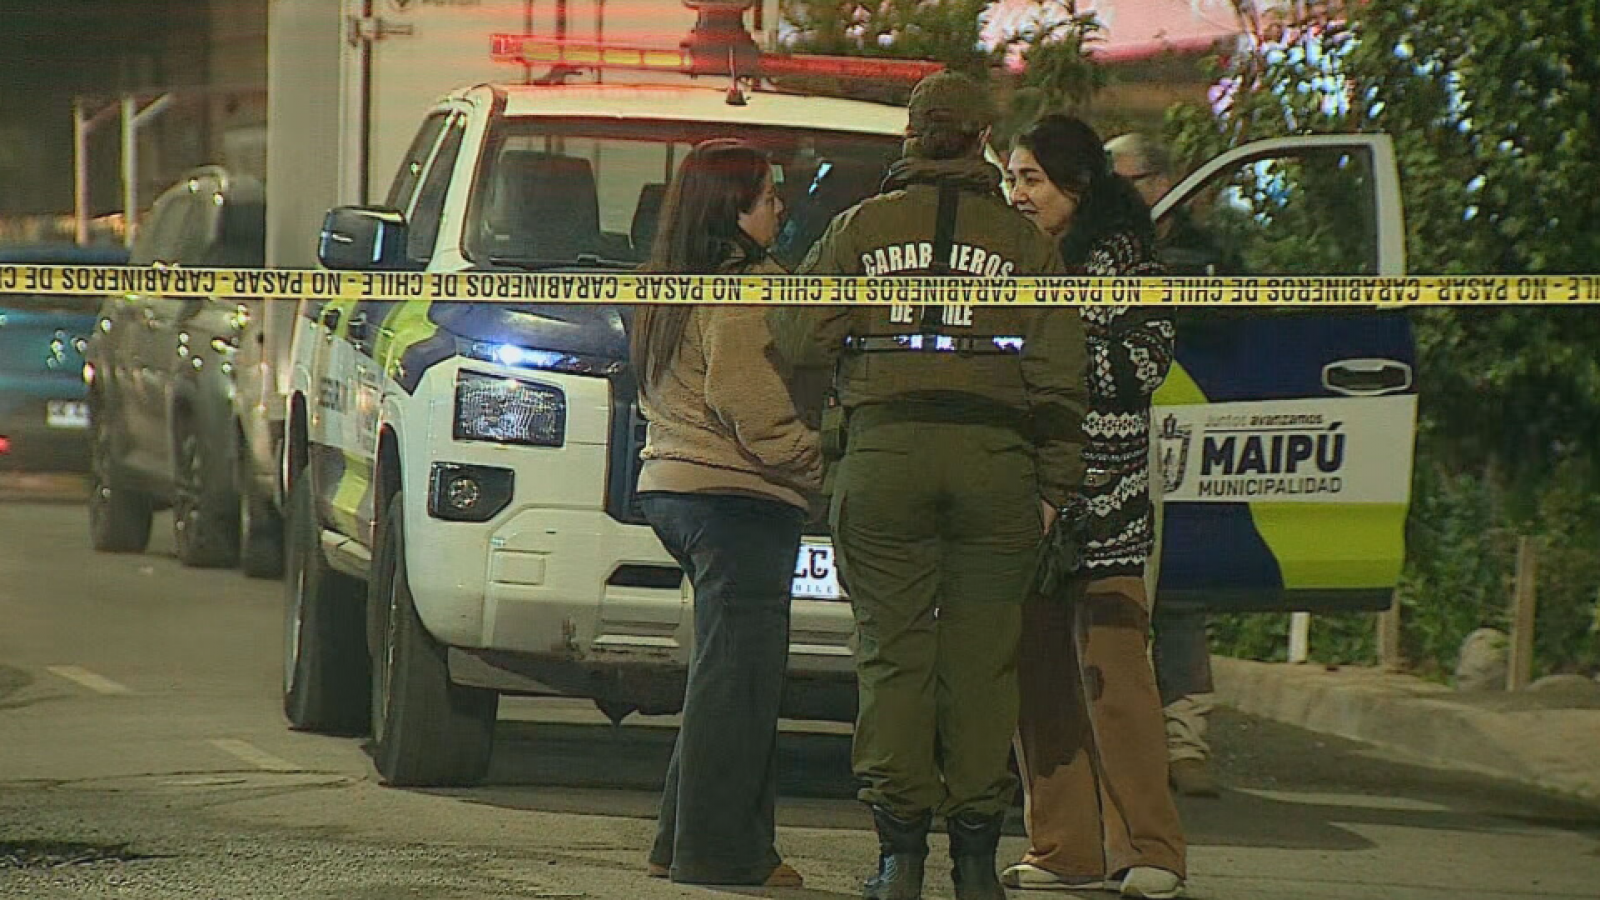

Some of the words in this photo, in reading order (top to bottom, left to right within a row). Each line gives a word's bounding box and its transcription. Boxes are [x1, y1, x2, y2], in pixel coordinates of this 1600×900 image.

[861, 242, 1015, 278] CARABEROS
[25, 267, 53, 290] DE
[62, 268, 216, 293] CARABINEROS
[312, 273, 341, 294] NO
[361, 273, 423, 296] CHILE
[432, 274, 457, 296] DE
[467, 274, 618, 299] CARABINEROS
[713, 277, 742, 300] NO
[761, 277, 822, 300] CHILE
[832, 278, 857, 300] DE
[866, 278, 1017, 301] CARABINEROS
[1112, 279, 1141, 301] NO
[1162, 279, 1223, 301] CHILE
[1232, 279, 1258, 301] DE
[1265, 278, 1420, 301] CARABINEROS
[1517, 278, 1547, 301] NO
[1249, 414, 1323, 426] avanzamos
[1200, 422, 1345, 476] MAIPÚ
[1198, 477, 1342, 497] MUNICIPALIDAD
